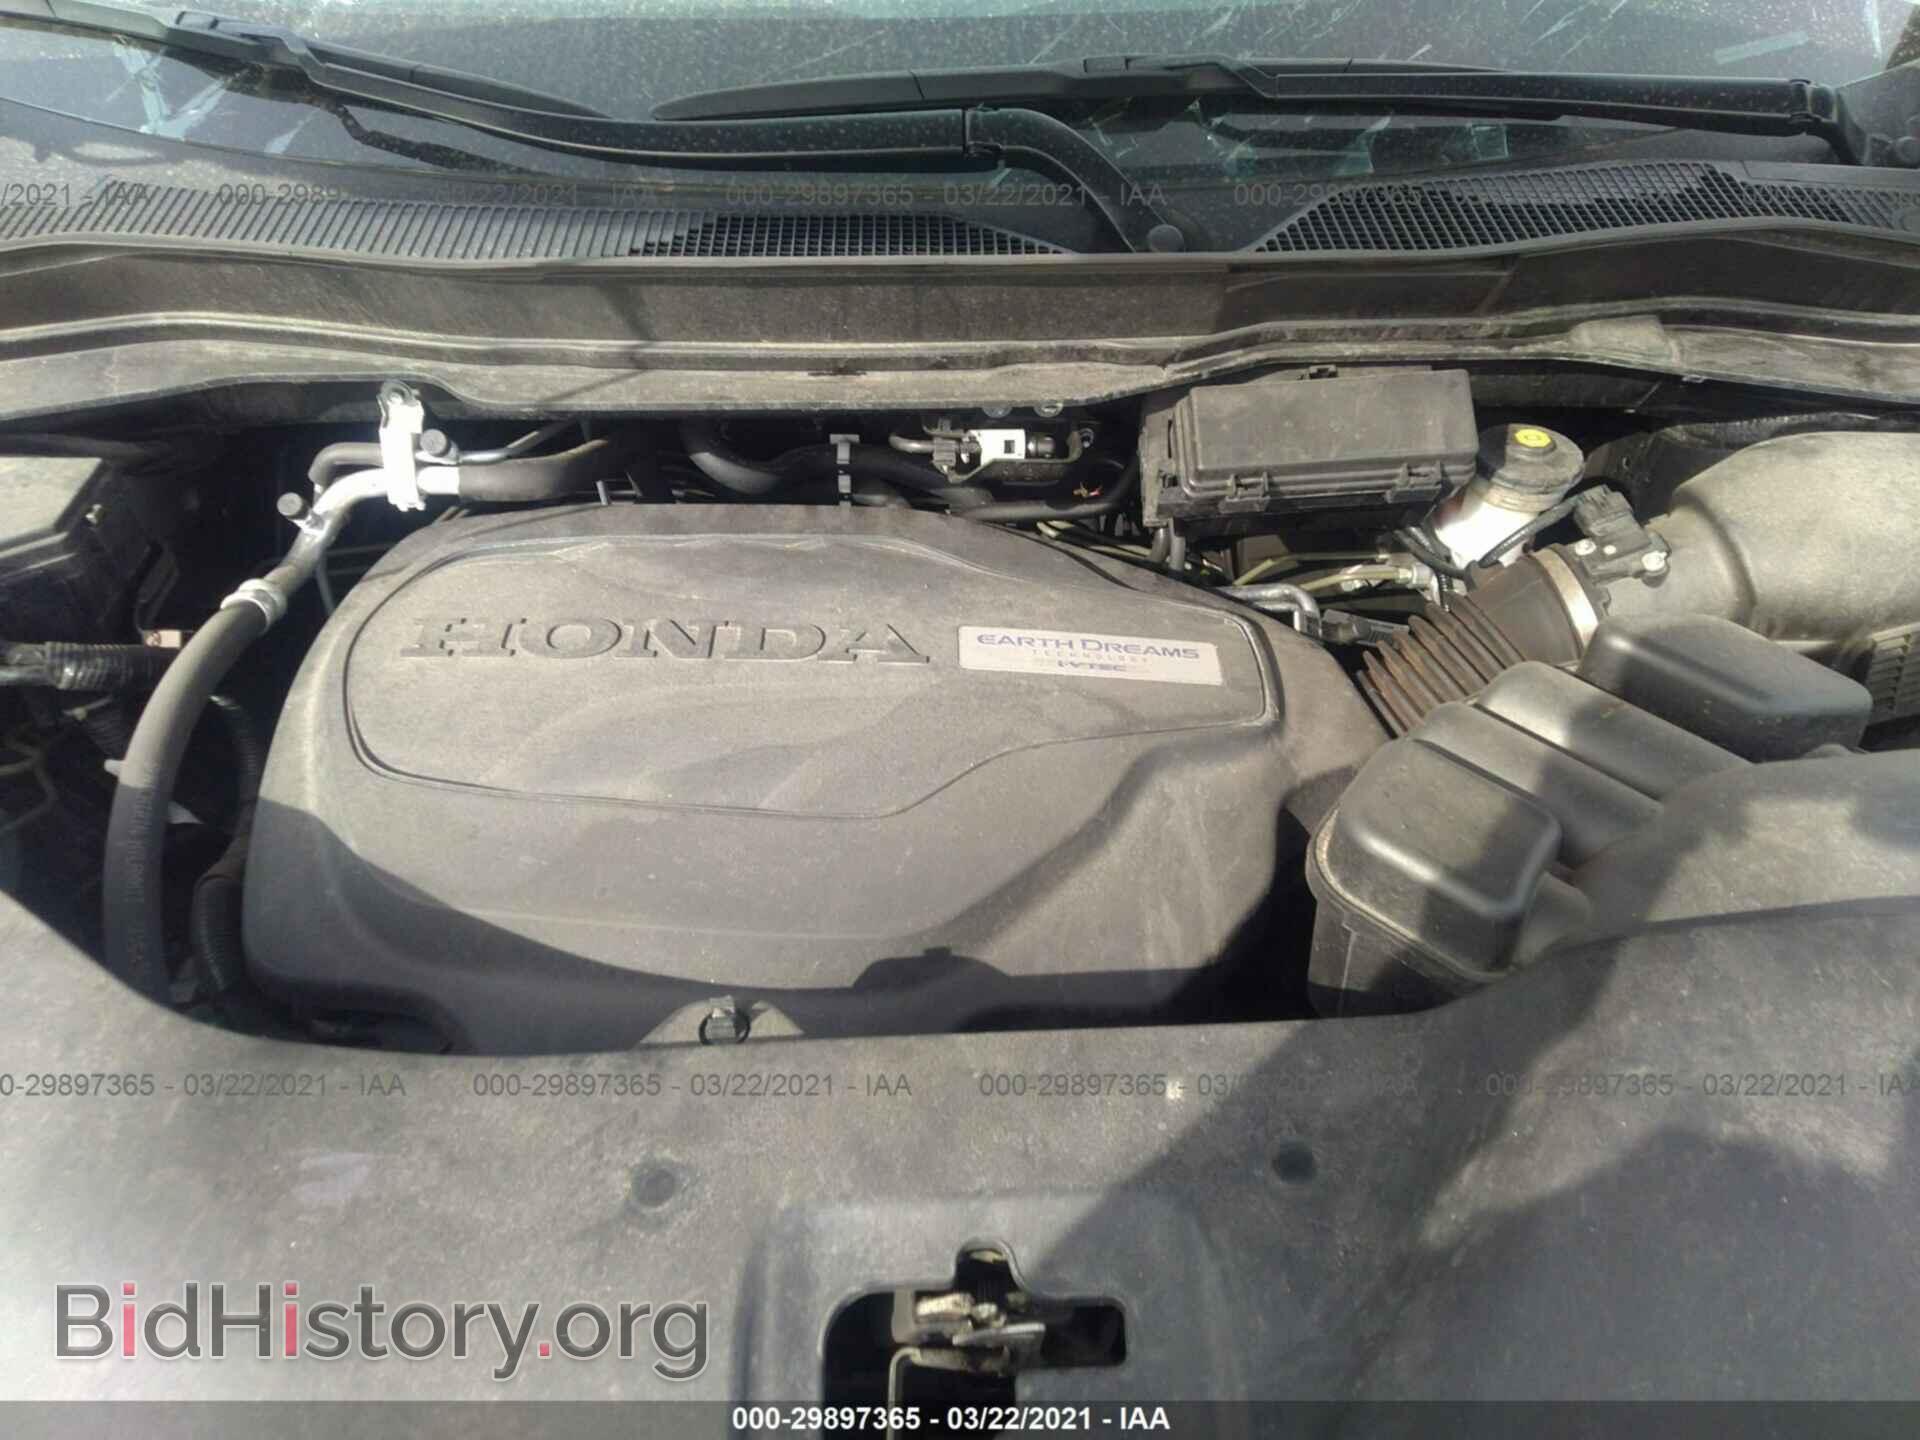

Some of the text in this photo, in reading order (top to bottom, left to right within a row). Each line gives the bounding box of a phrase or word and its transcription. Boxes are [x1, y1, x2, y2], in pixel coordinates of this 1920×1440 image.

[399, 617, 930, 665] HONDA
[976, 633, 1201, 660] EARTH DREAMS
